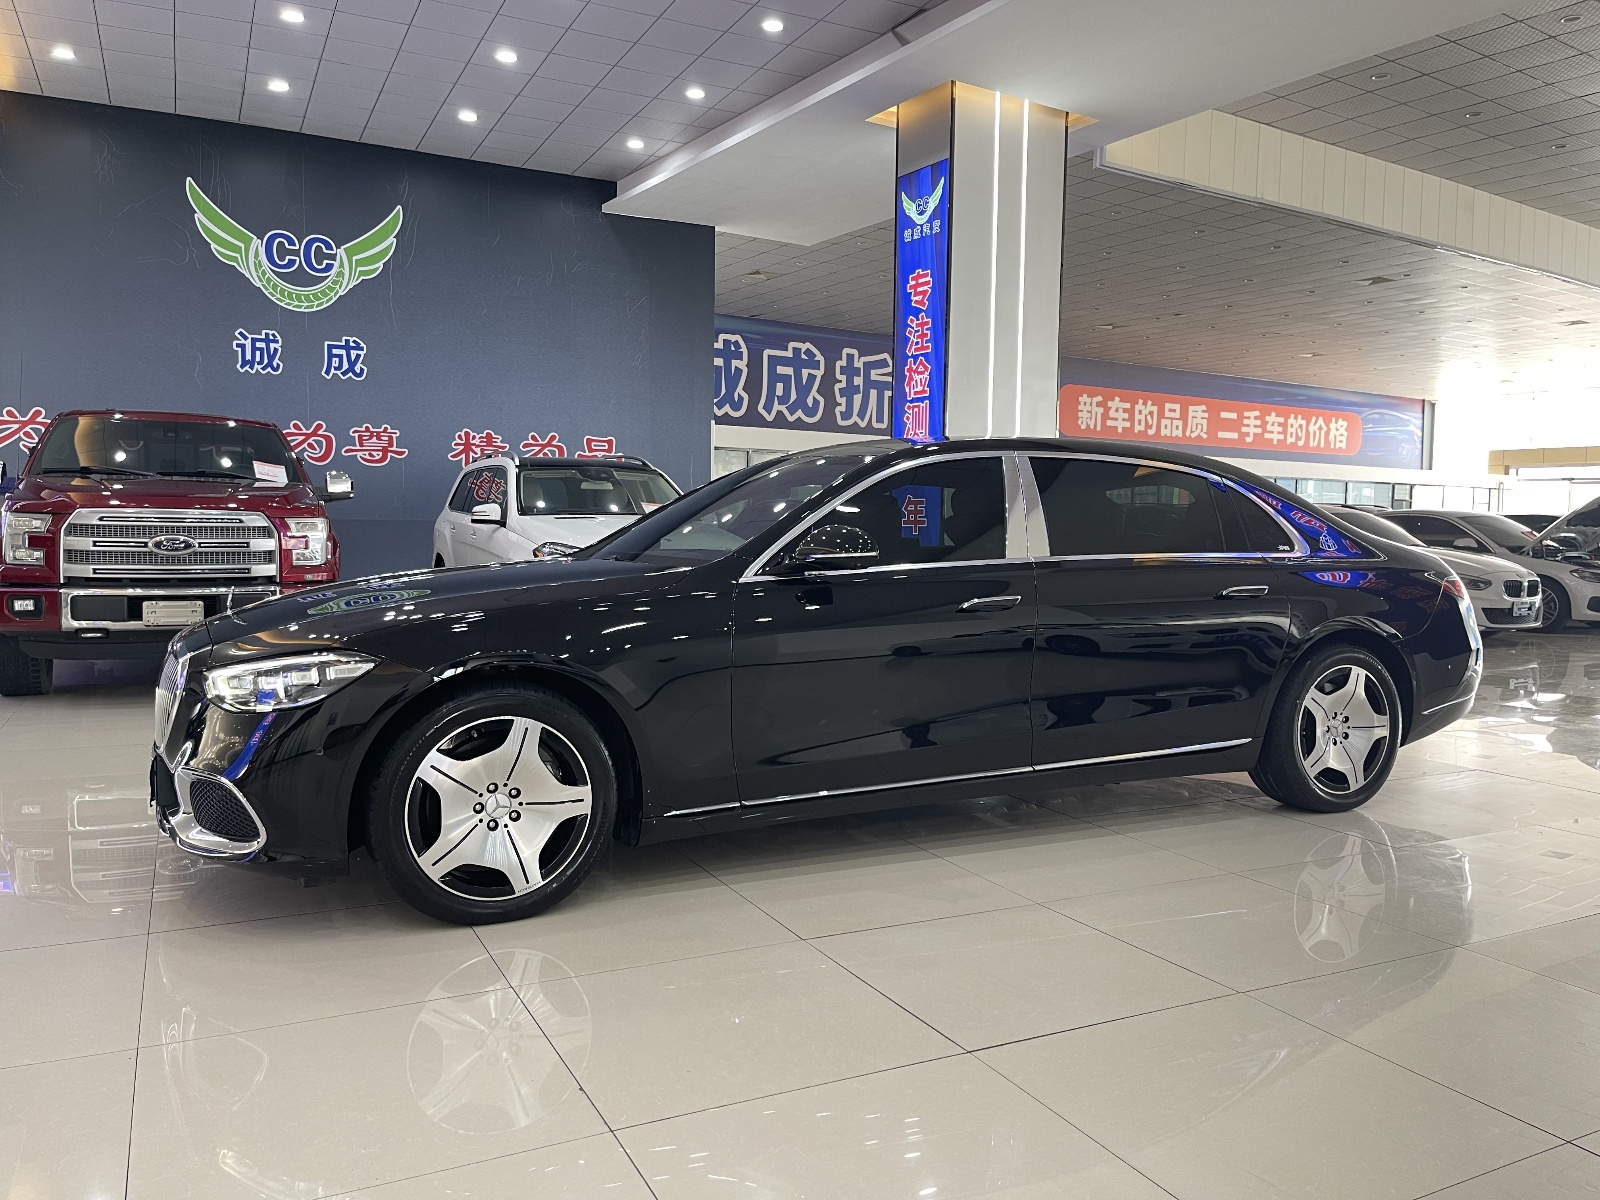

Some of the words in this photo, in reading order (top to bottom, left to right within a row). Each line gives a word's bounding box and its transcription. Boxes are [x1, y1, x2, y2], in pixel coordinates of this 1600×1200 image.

[262, 230, 336, 276] CC
[233, 328, 367, 380] 诚成
[904, 269, 932, 438] 专注检测
[1077, 394, 1209, 440] 新车的品质
[1217, 410, 1348, 450] 二手车的价格
